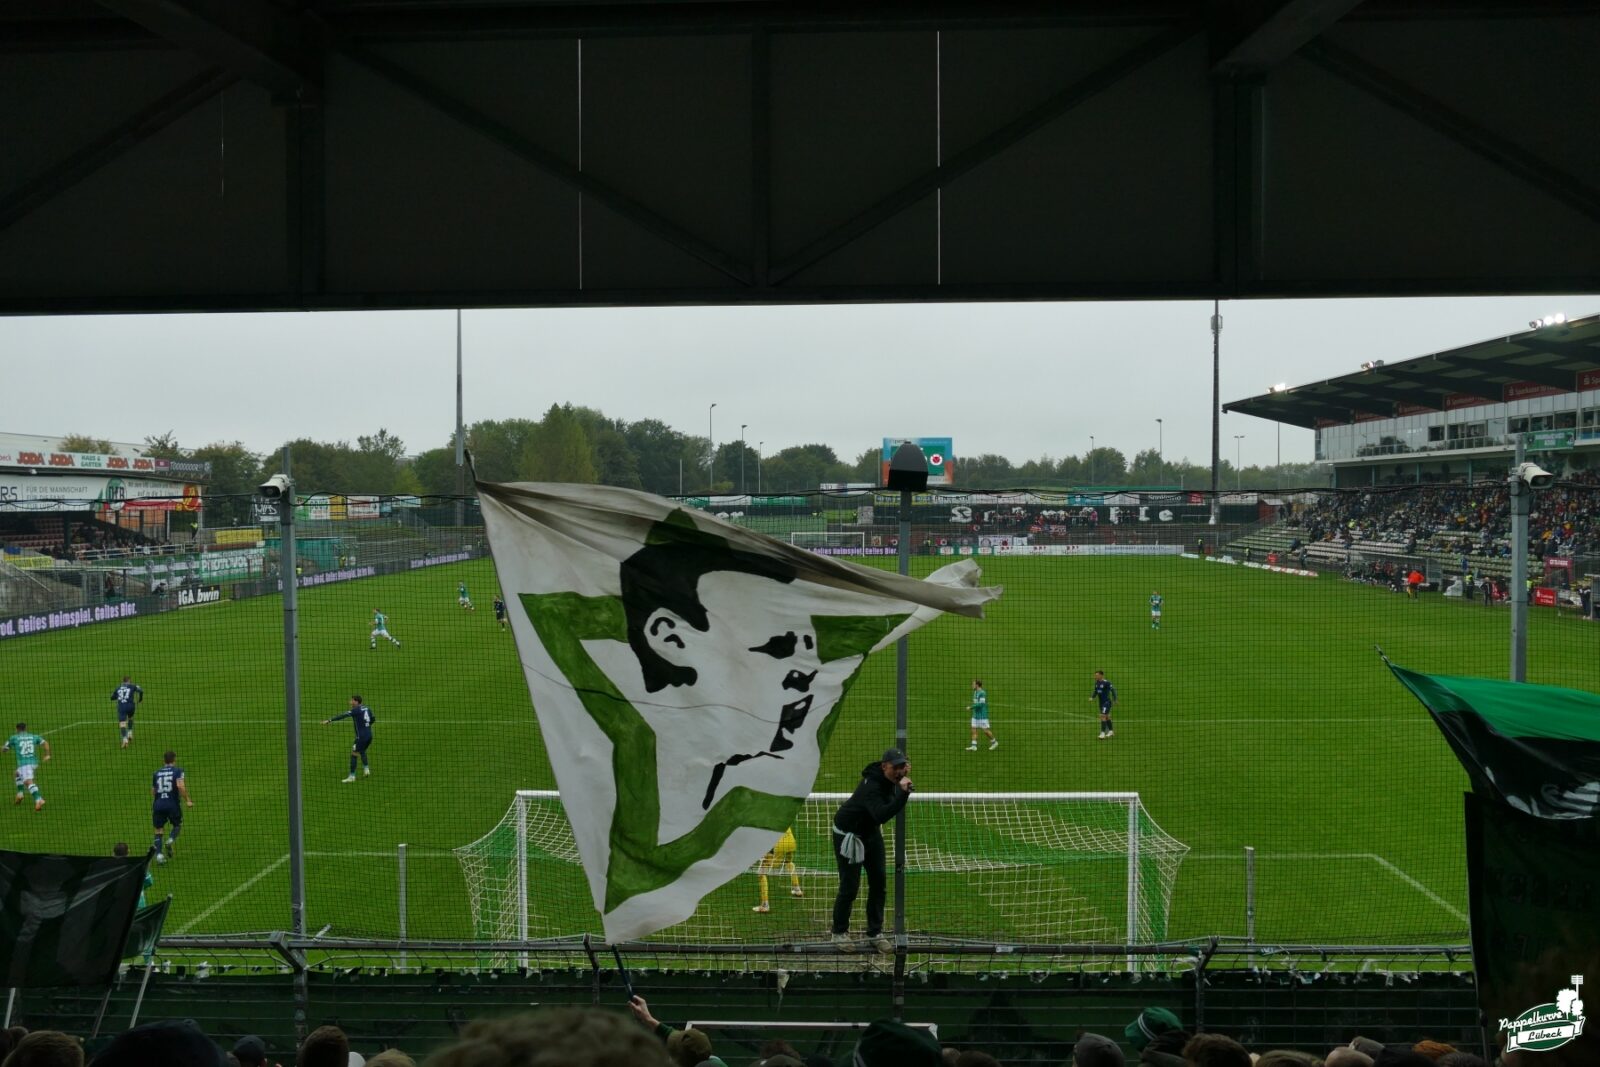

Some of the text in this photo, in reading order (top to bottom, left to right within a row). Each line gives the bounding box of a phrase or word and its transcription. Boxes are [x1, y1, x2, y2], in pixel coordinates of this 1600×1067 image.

[16, 451, 45, 465] JODA
[48, 453, 75, 466] JODA
[106, 457, 130, 469] JODA
[132, 458, 154, 470] JODA
[18, 615, 47, 634] Geiles
[48, 607, 94, 627] Heimspiel.
[94, 604, 120, 621] Geiles
[157, 775, 173, 793] 15
